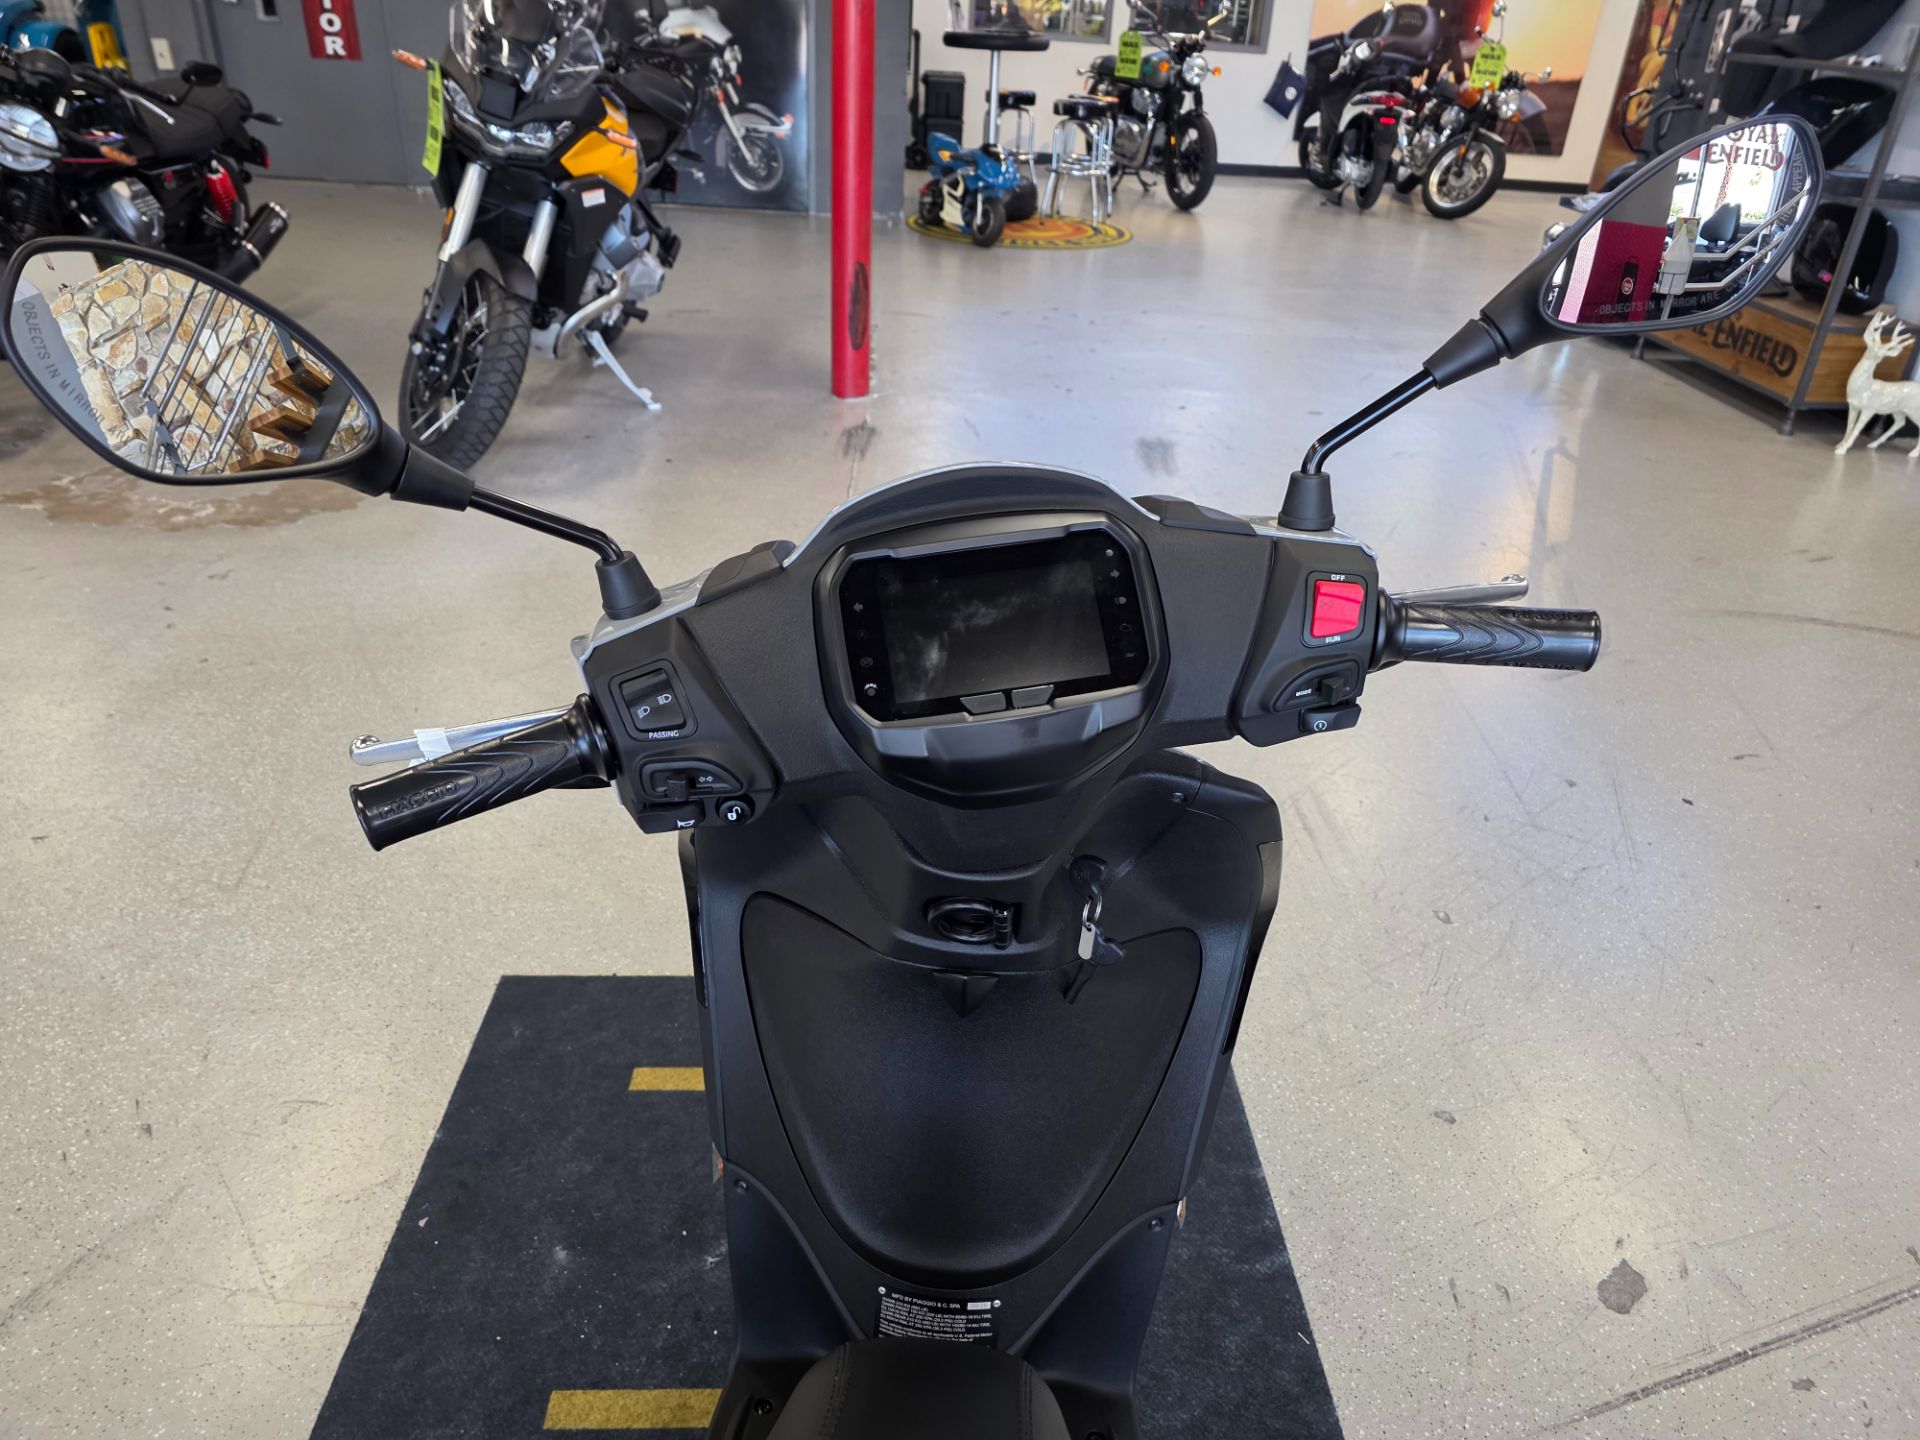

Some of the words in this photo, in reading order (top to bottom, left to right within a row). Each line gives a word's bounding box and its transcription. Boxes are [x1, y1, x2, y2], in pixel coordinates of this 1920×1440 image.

[1707, 143, 1784, 171] ENFIELD
[1600, 301, 1644, 314] OBJECTS
[1660, 295, 1698, 309] MRROR
[1700, 291, 1720, 304] ARE
[21, 301, 50, 361] OBJECTS
[45, 362, 62, 379] IN
[1712, 318, 1798, 378] ENFIELD
[1331, 574, 1346, 582] OFF
[1325, 635, 1341, 644] RUN
[1295, 688, 1312, 697] MODE
[648, 730, 680, 740] PASSING
[912, 1298, 937, 1307] PIAGGIO
